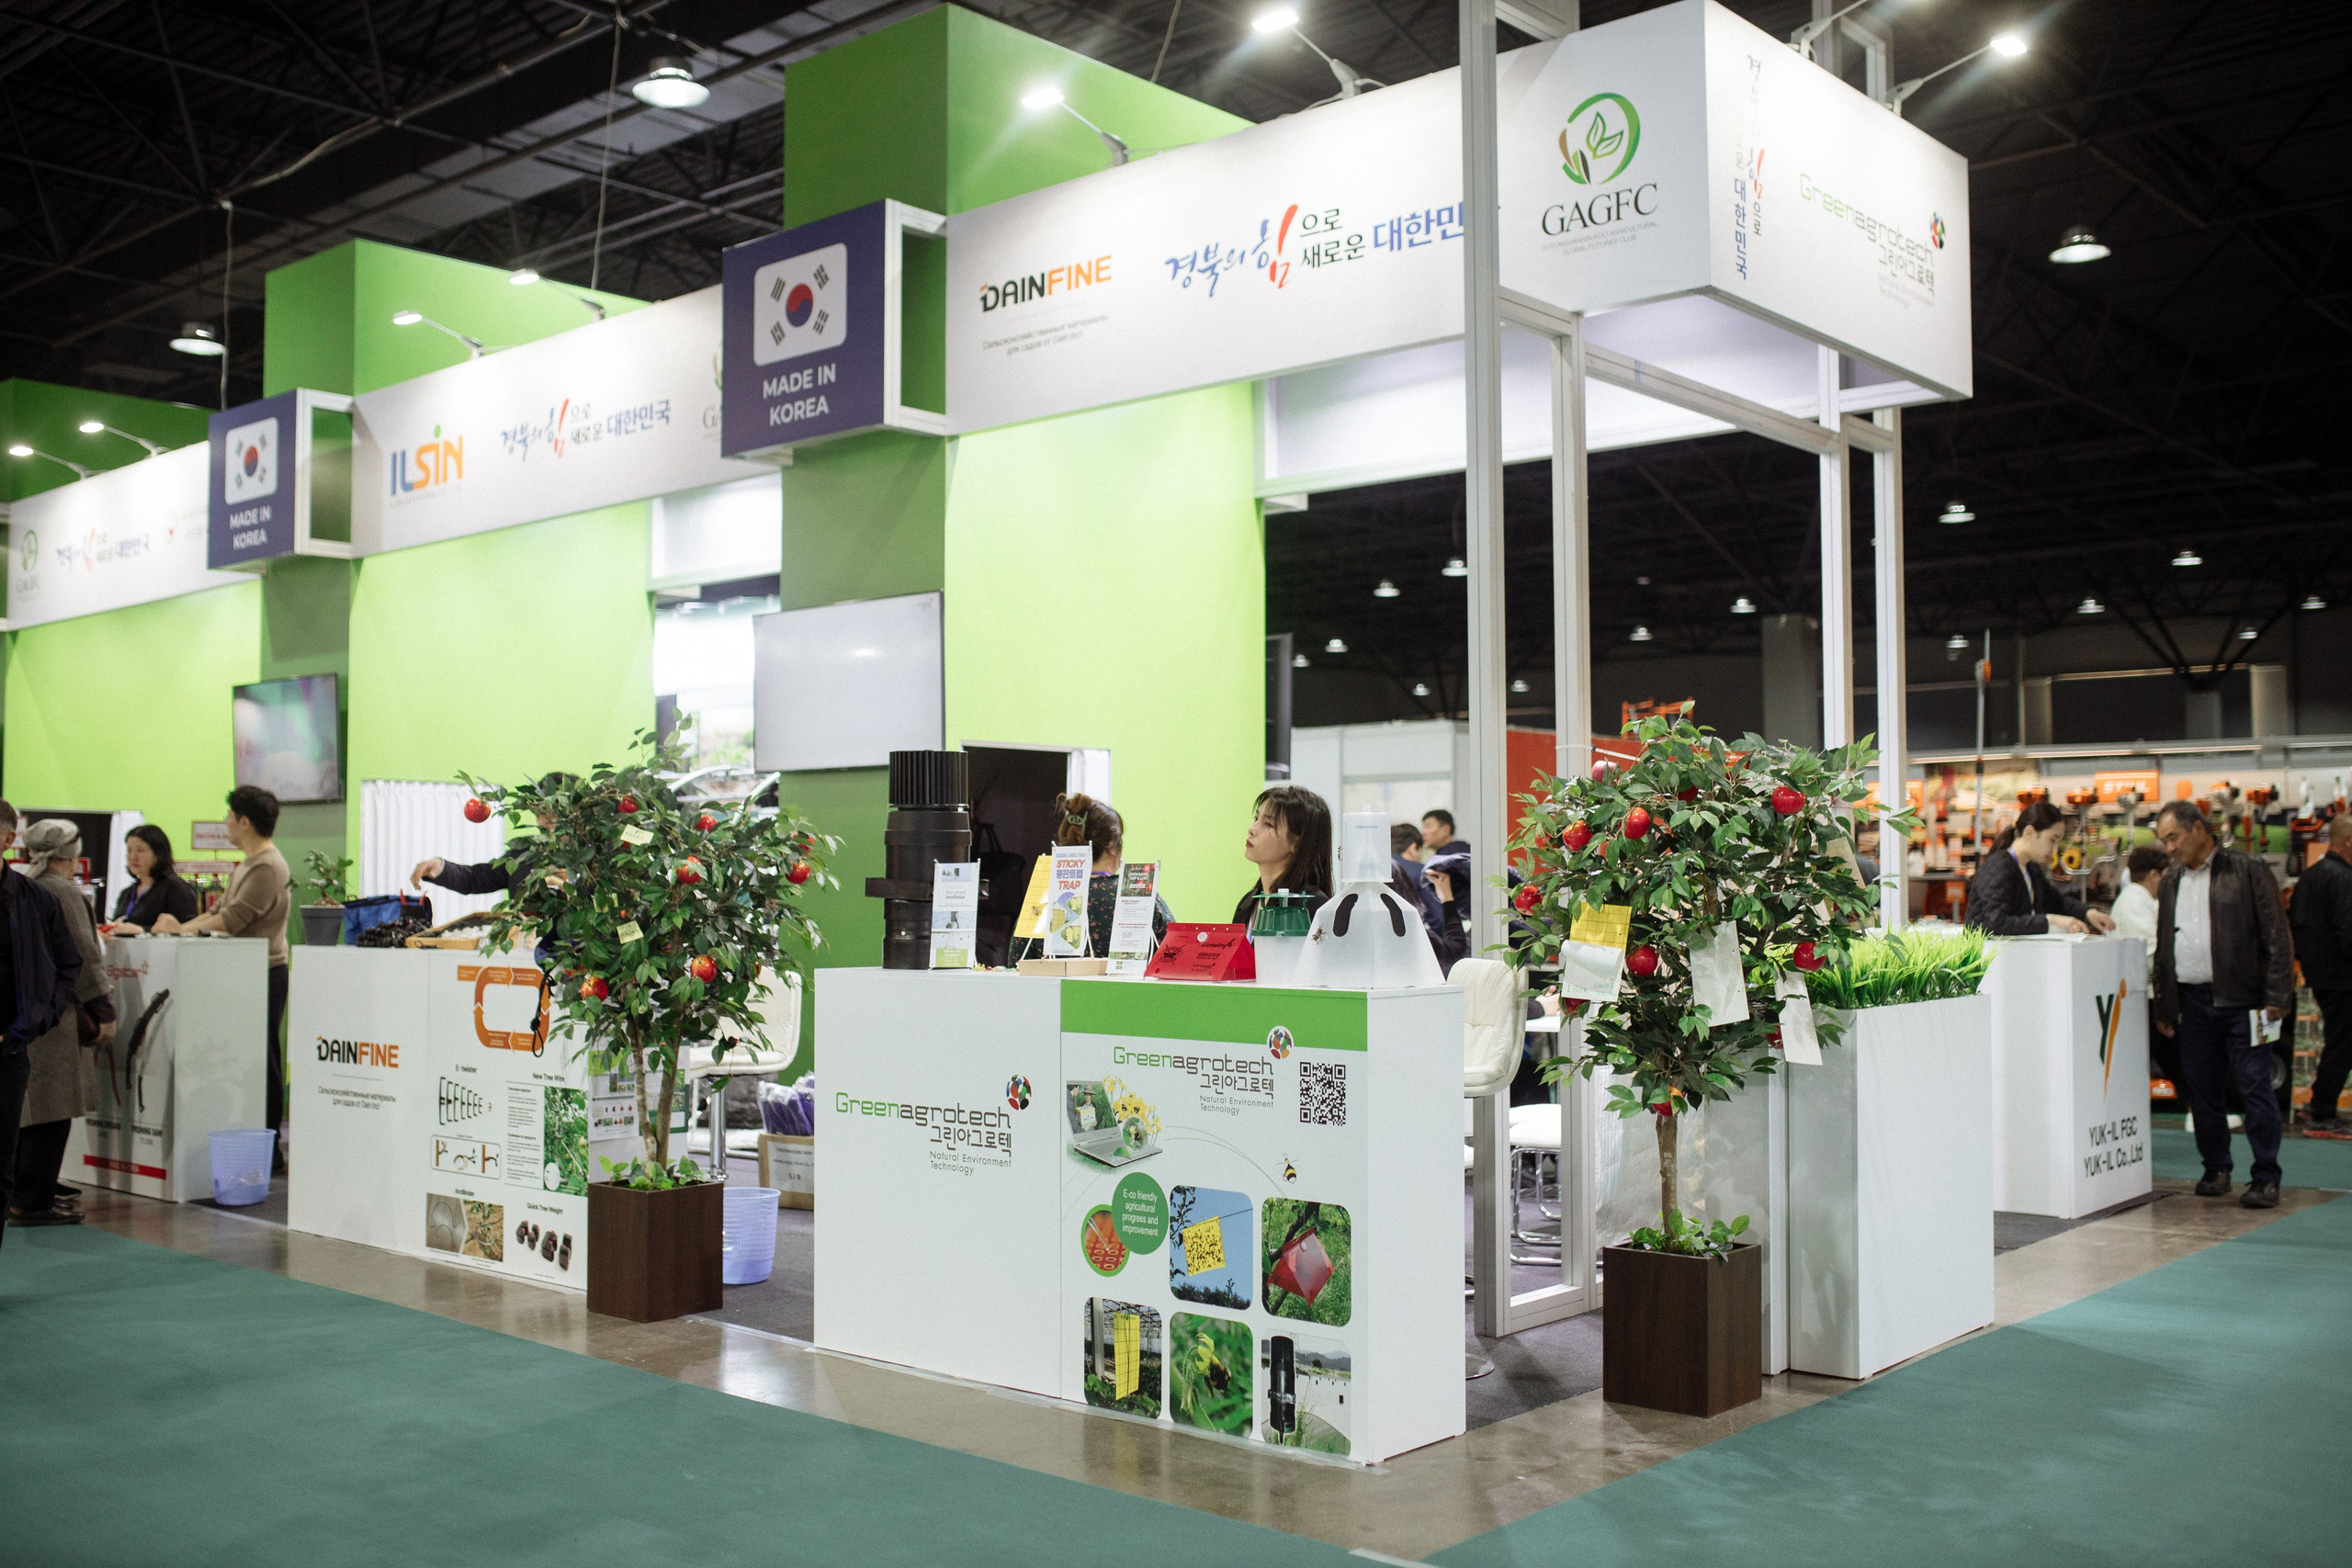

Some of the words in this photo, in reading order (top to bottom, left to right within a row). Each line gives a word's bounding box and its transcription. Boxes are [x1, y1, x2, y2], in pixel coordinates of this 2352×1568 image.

[1542, 182, 1658, 236] GAGFC
[1801, 173, 1933, 266] Greenagrotech
[1301, 234, 1365, 268] 새로운
[1373, 199, 1464, 252] 대한민
[979, 254, 1113, 313] DAINFINE
[763, 367, 813, 400] MADE
[818, 362, 837, 389] IN
[607, 399, 671, 436] 대한민국
[769, 395, 829, 427] KOREA
[230, 506, 258, 530] MADE
[259, 504, 271, 523] IN
[233, 527, 268, 550] KOREA
[1057, 860, 1085, 868] STICKY
[1058, 880, 1080, 889] TRAP
[316, 1035, 400, 1068] DAINFINE
[1114, 1046, 1273, 1075] Greenagrotech
[544, 1073, 553, 1081] Tree
[1200, 1073, 1274, 1100] 그린아그로텍
[835, 1091, 1012, 1129] Greenagrotech
[1199, 1095, 1227, 1104] Natural
[1229, 1098, 1273, 1108] Environment
[1200, 1103, 1239, 1116] Technology
[930, 1125, 1012, 1157] 그린아그로텍
[2089, 1120, 2119, 1147] YUK-IL
[2121, 1116, 2138, 1141] FGC
[929, 1150, 959, 1162] Natural
[963, 1154, 1012, 1168] Environment
[930, 1160, 974, 1176] Technology
[2084, 1151, 2115, 1179] YUK-IL
[1123, 1189, 1136, 1199] E-co
[1136, 1190, 1158, 1203] friendly
[1125, 1201, 1156, 1213] agricultural
[548, 1206, 563, 1214] Weight
[1122, 1213, 1147, 1224] progress
[1148, 1216, 1158, 1224] and
[1122, 1223, 1158, 1236] improvement
